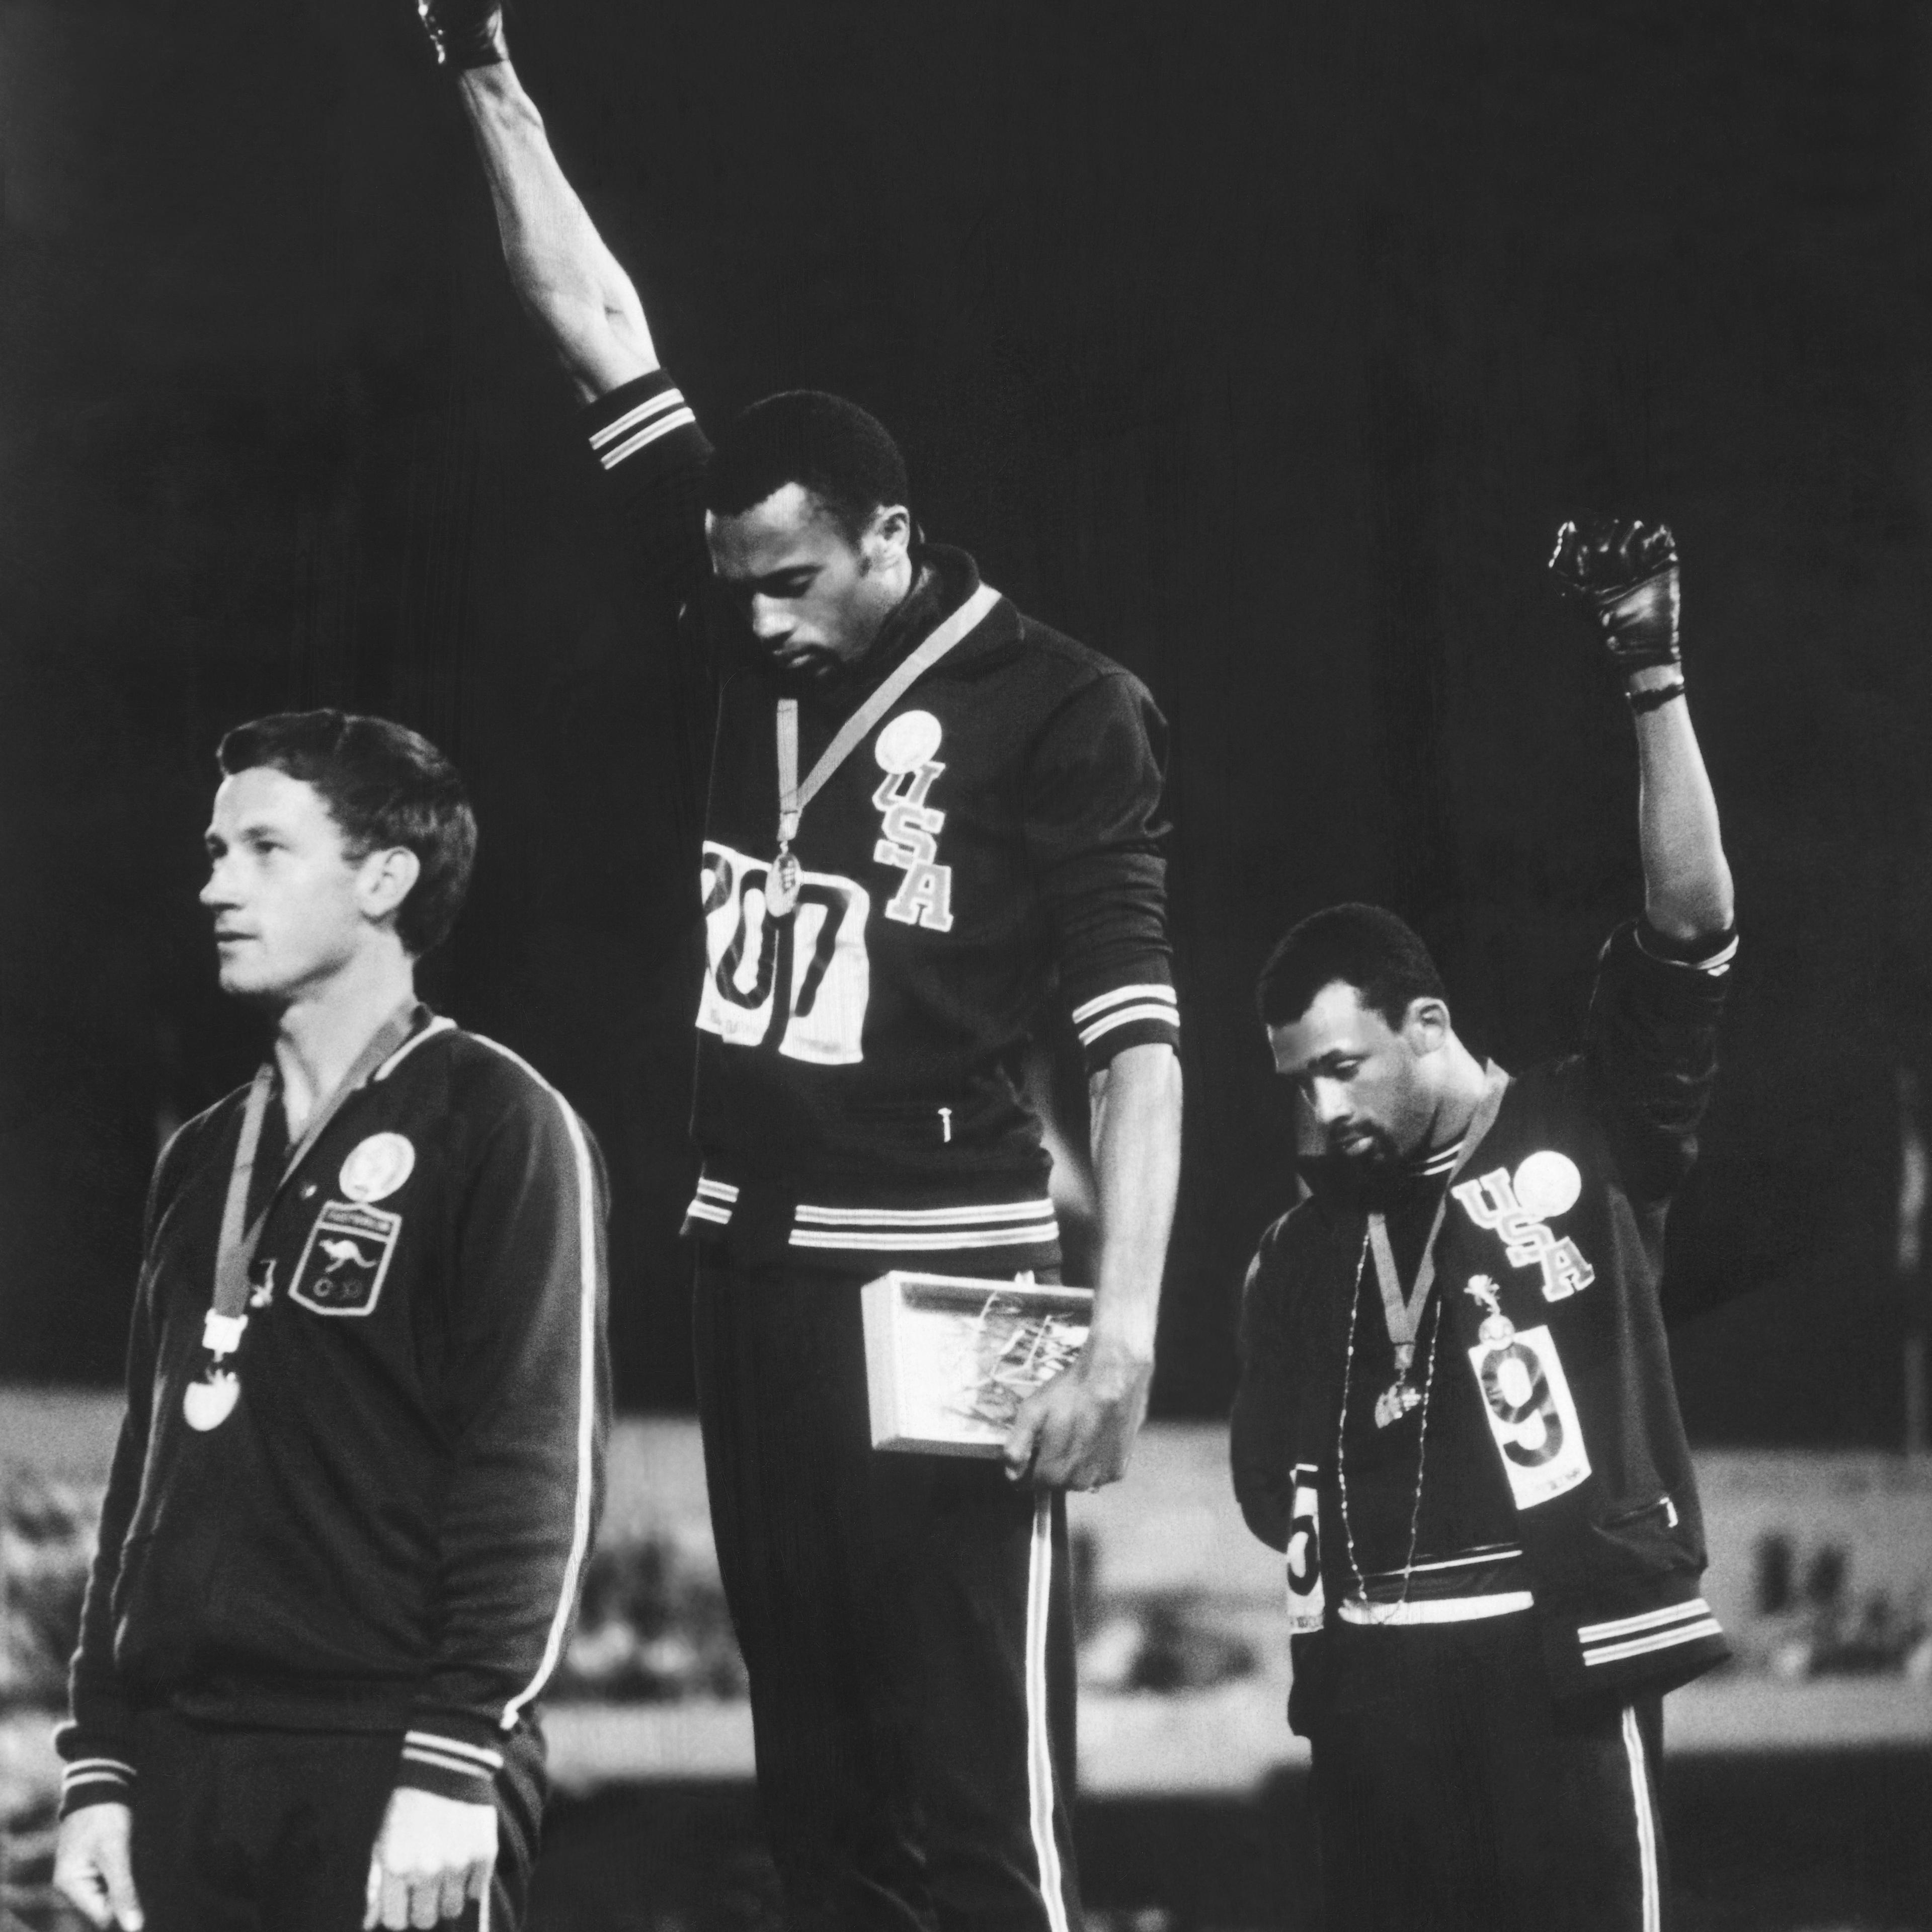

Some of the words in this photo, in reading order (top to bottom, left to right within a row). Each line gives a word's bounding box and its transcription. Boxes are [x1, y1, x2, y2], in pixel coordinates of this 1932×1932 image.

[872, 761, 953, 932] USA
[1452, 1167, 1595, 1302] USA
[1480, 1342, 1564, 1468] 9
